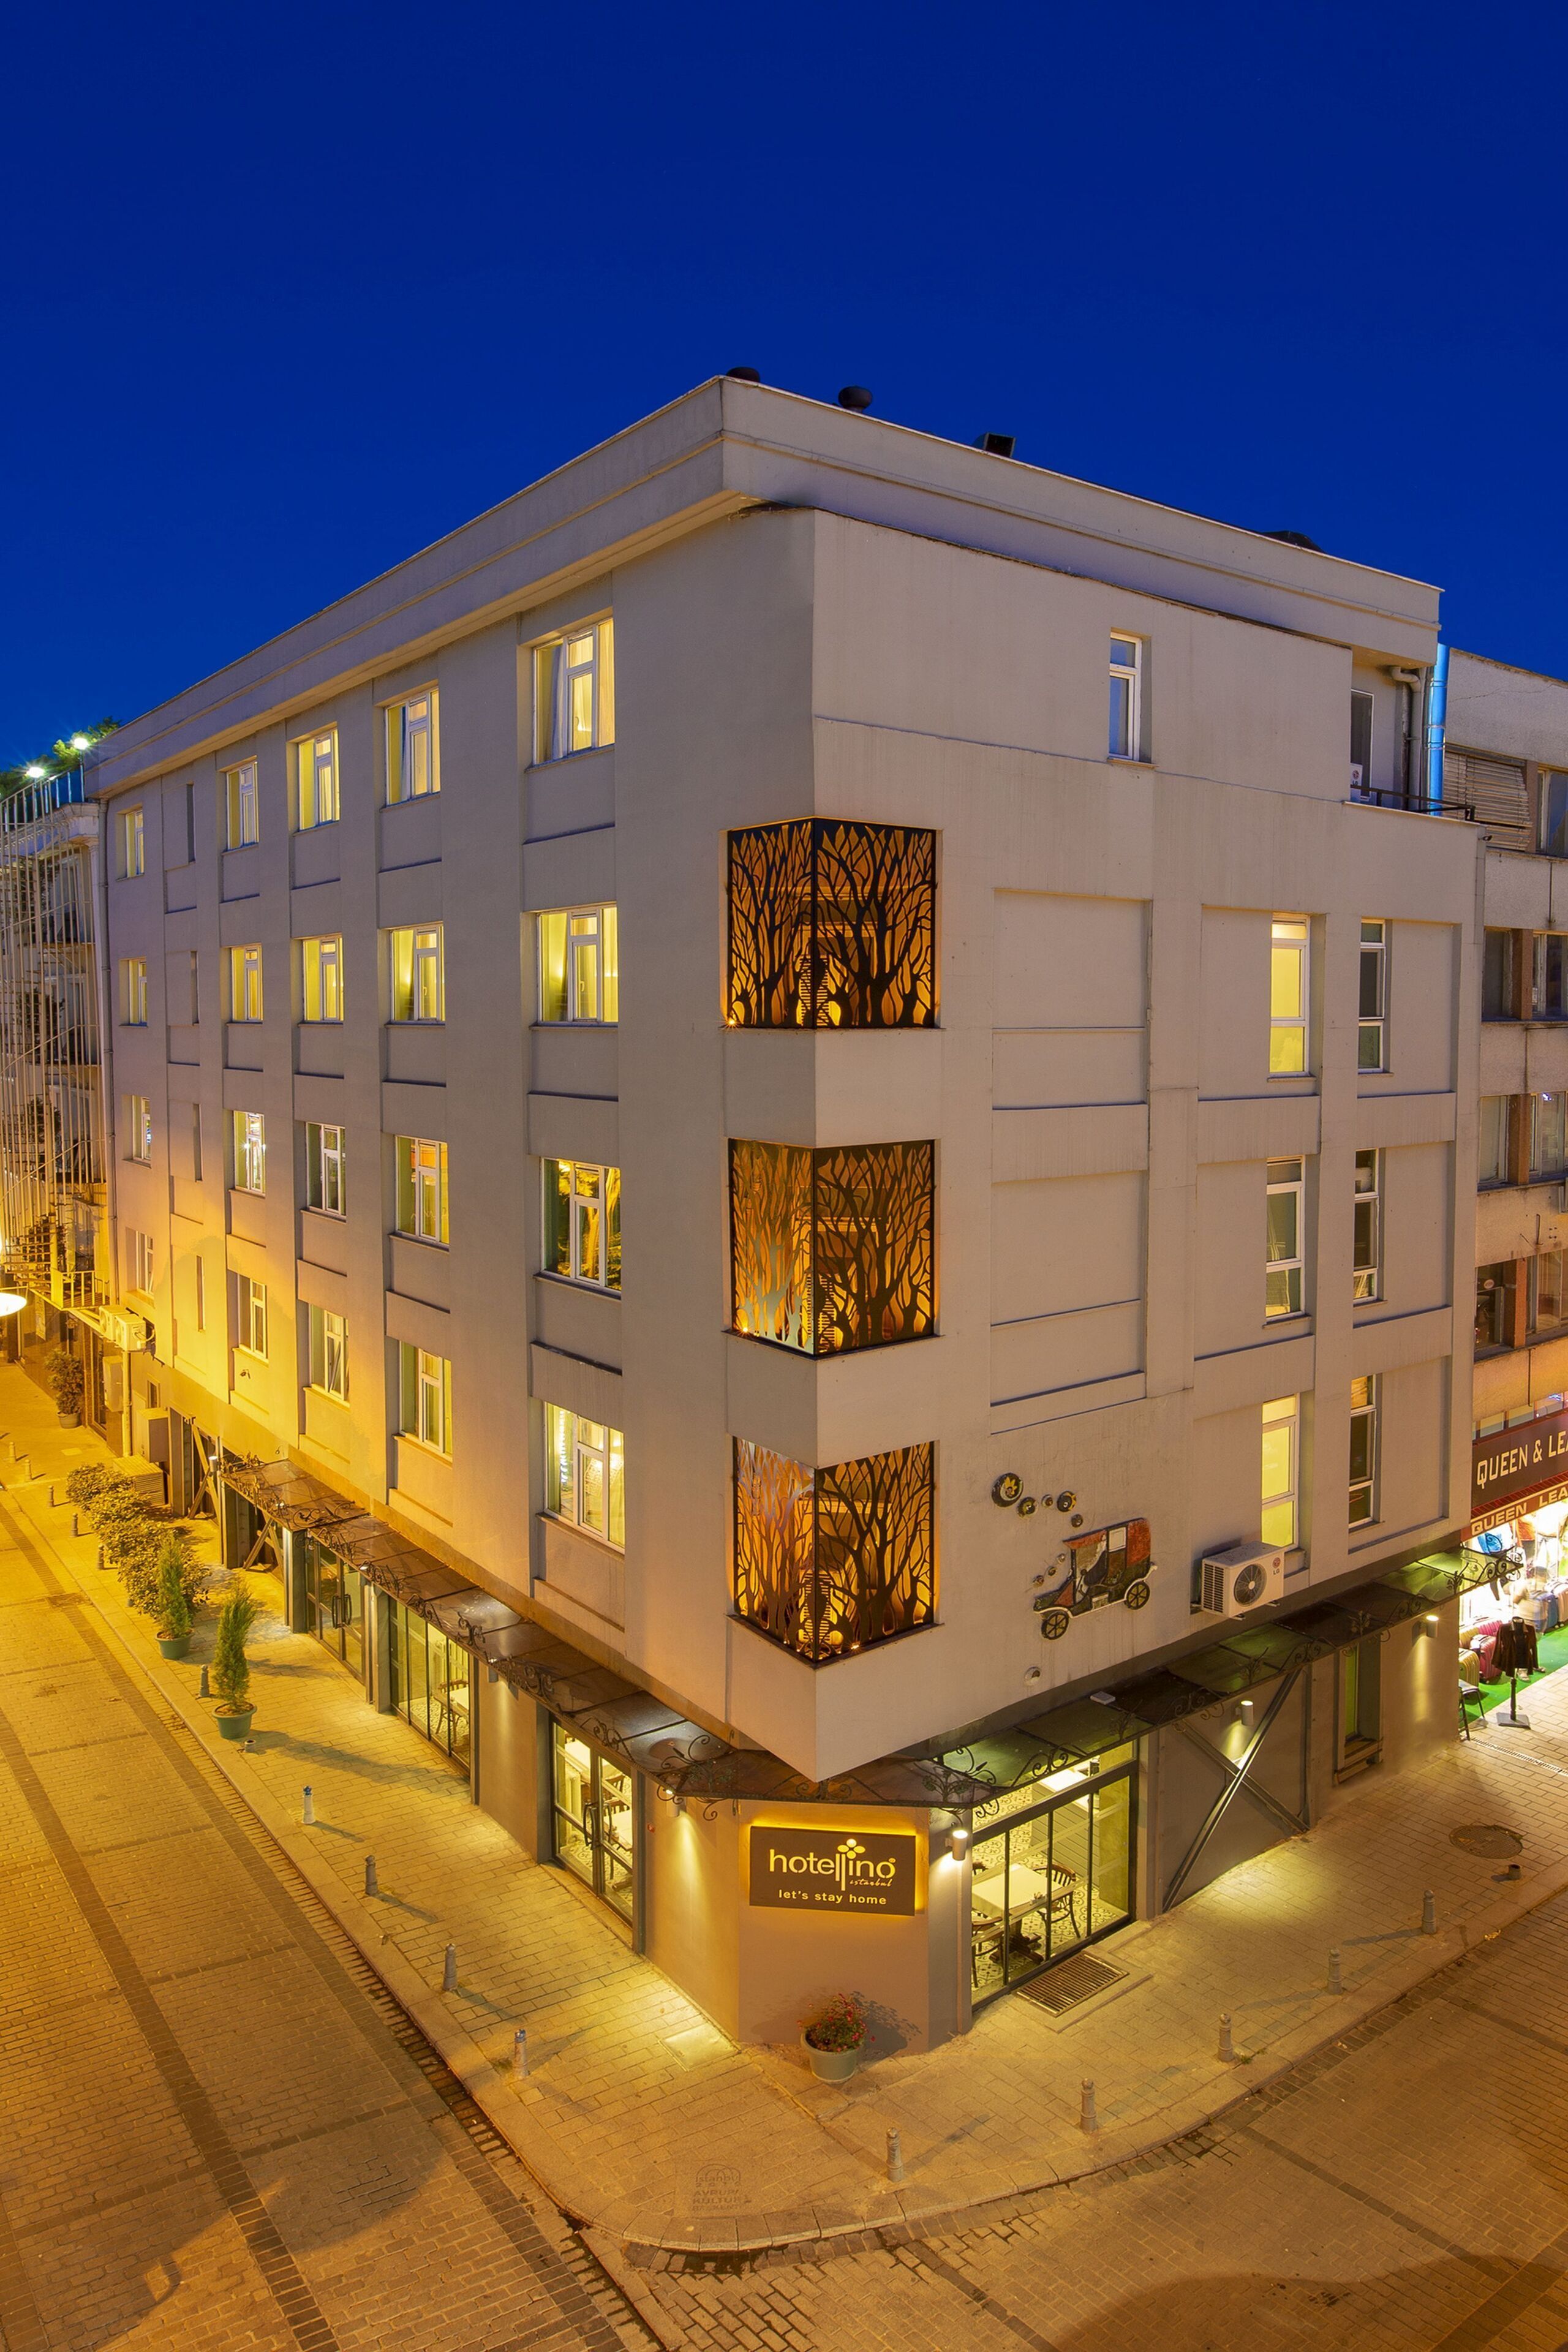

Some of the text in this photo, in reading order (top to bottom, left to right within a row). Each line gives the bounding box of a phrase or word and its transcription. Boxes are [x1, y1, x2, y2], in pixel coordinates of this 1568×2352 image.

[1477, 1430, 1568, 1490] QUEEN & LE
[1471, 1502, 1527, 1536] QUEEN
[769, 1848, 896, 1891] hotellino
[850, 1878, 893, 1887] istanbul
[778, 1889, 887, 1905] let's stay home
